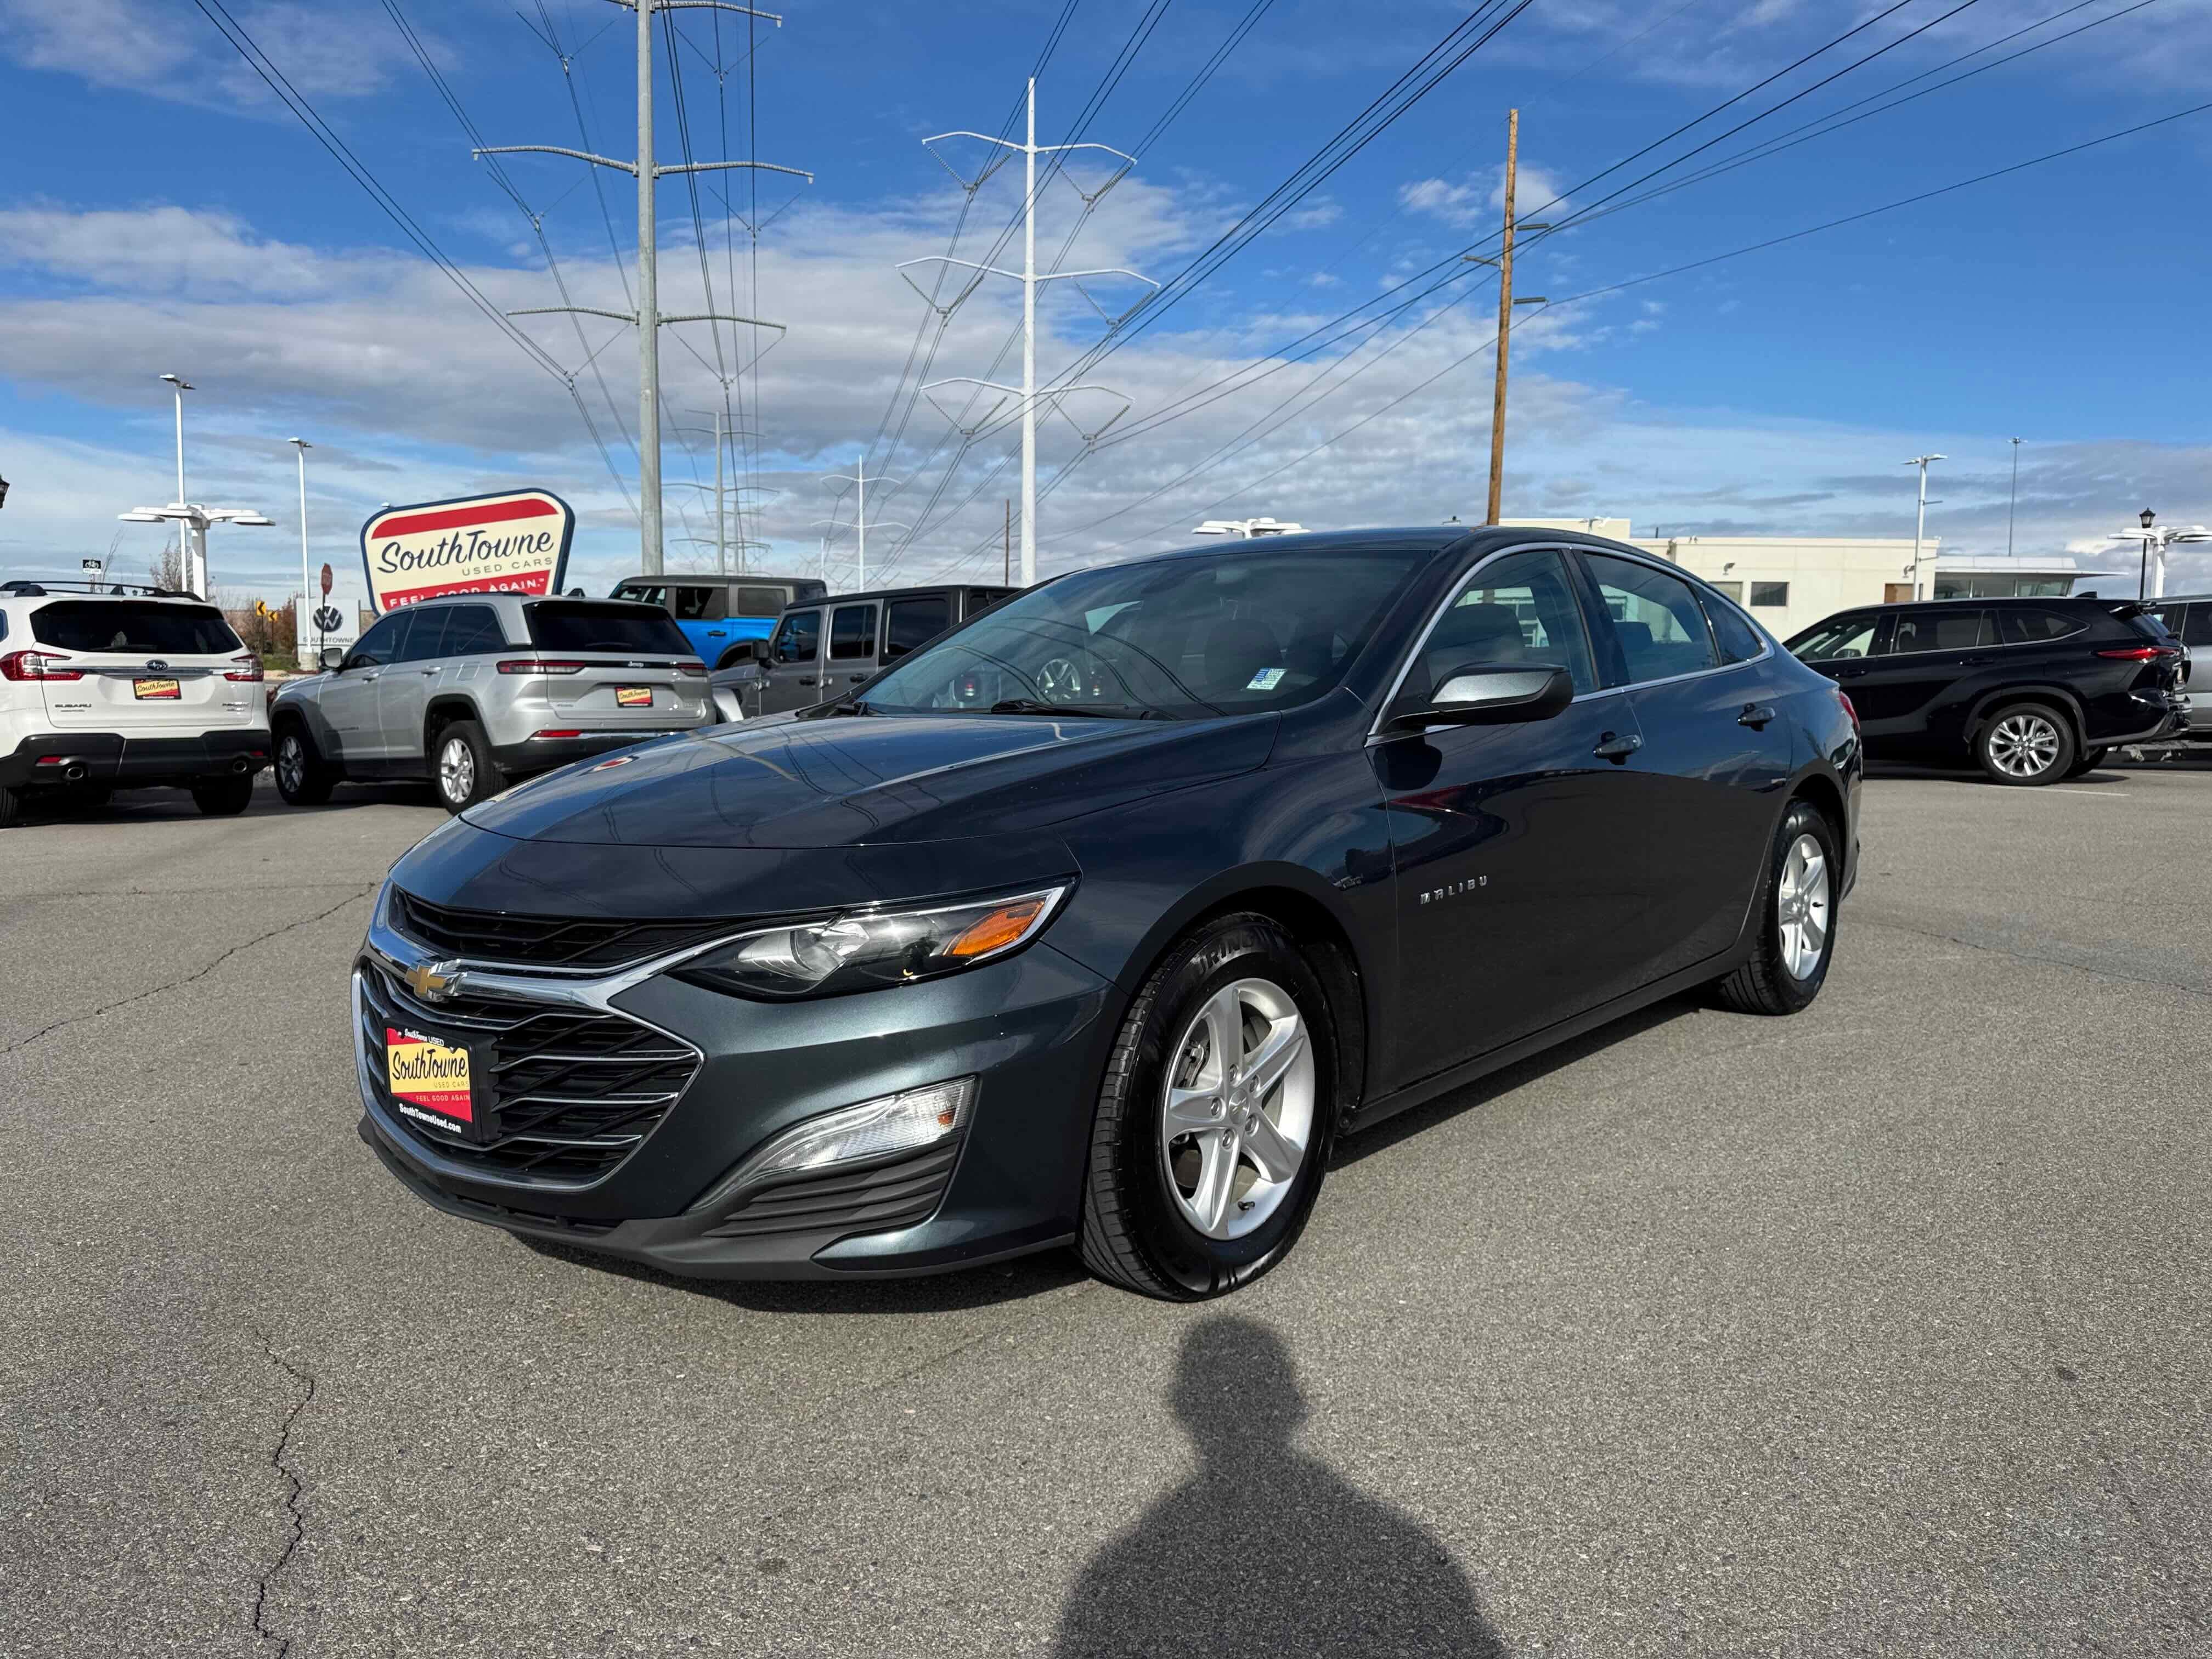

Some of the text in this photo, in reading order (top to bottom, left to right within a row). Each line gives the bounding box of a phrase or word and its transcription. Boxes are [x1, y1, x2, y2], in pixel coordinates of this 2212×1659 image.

[377, 530, 554, 573] SouthTowne
[462, 557, 553, 576] USED CARS
[1420, 875, 1487, 905] MALIBU
[428, 1035, 444, 1046] USED
[392, 1047, 467, 1080] SouthTowne
[399, 1103, 462, 1134] SouthTowneUsed.com
